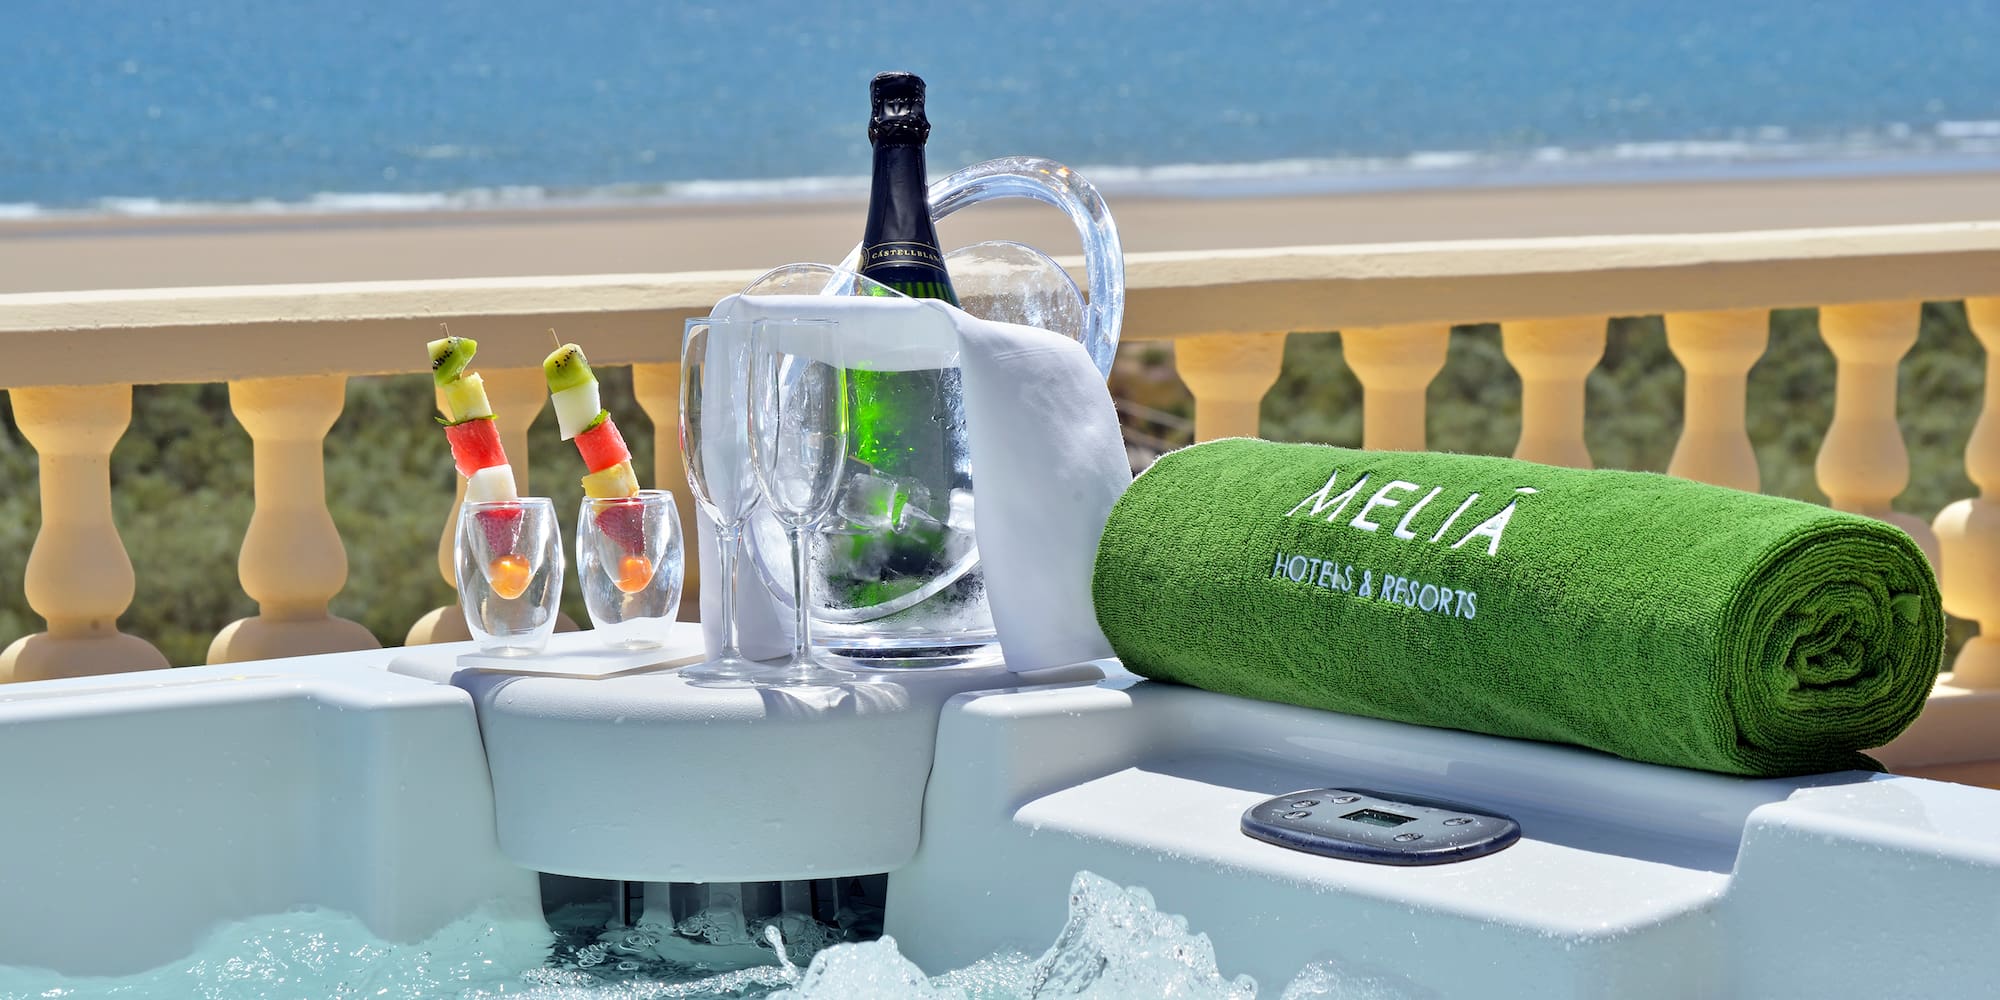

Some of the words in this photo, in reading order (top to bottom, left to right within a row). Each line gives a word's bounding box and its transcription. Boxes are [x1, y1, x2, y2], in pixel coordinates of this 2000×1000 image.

[1285, 470, 1540, 557] MELIÁ
[1272, 552, 1354, 592] HOTELS
[1358, 570, 1372, 597] &
[1380, 574, 1477, 620] RESORTS
